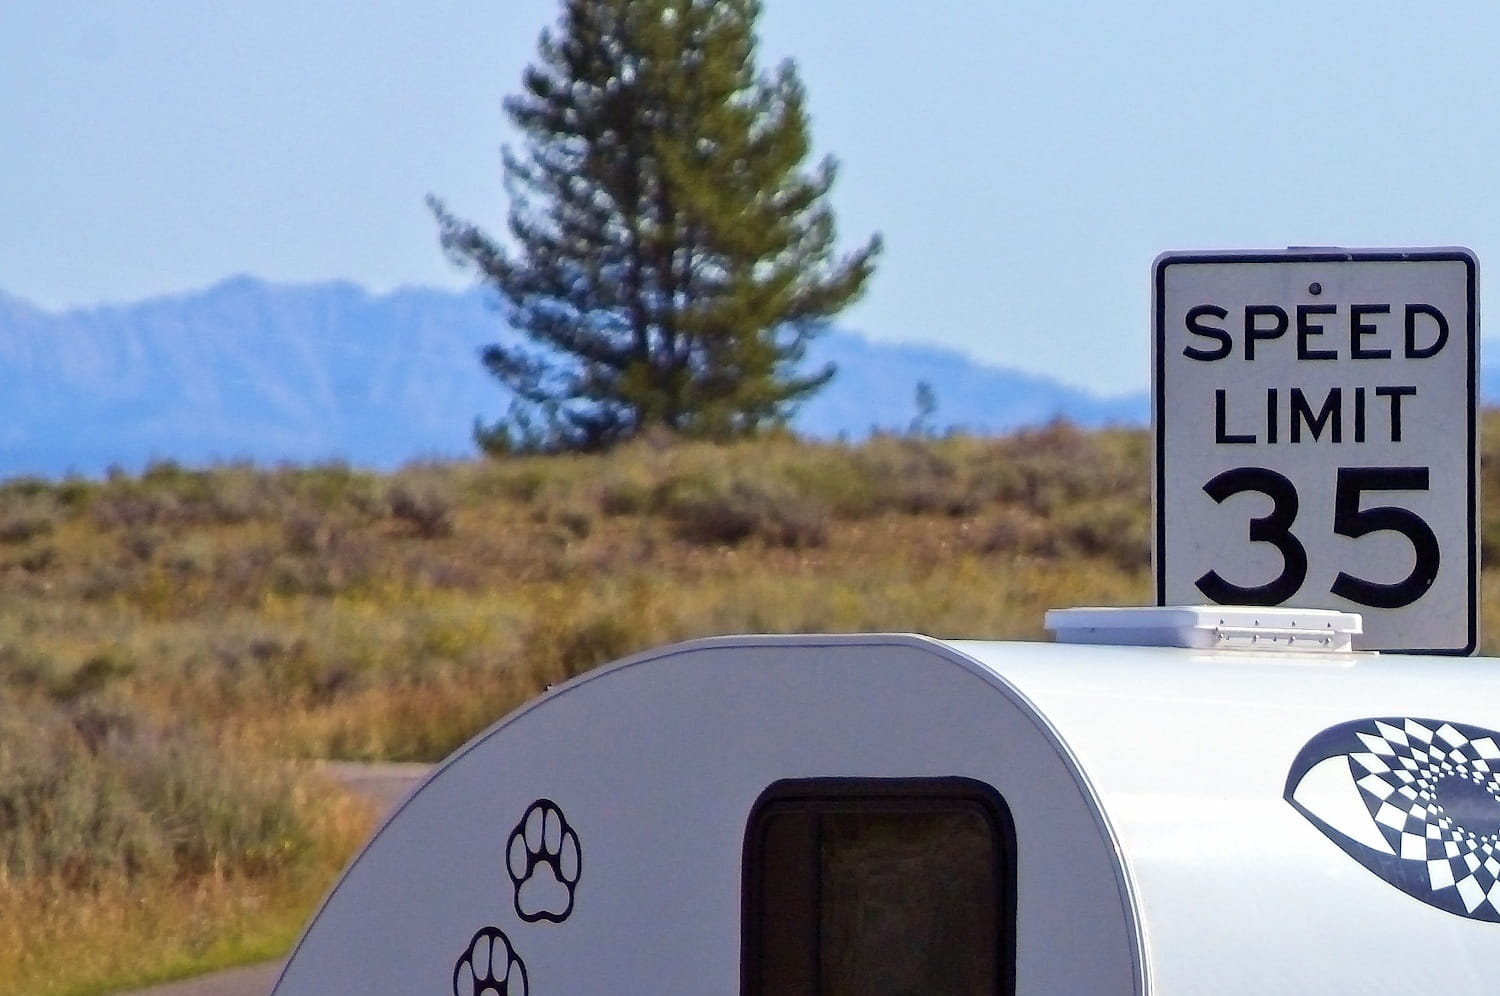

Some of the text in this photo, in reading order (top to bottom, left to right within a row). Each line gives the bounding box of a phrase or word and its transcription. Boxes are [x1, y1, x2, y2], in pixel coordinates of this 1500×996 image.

[1182, 303, 1449, 361] SPEED
[1215, 386, 1417, 444] LIMIT
[1195, 467, 1440, 608] 35
